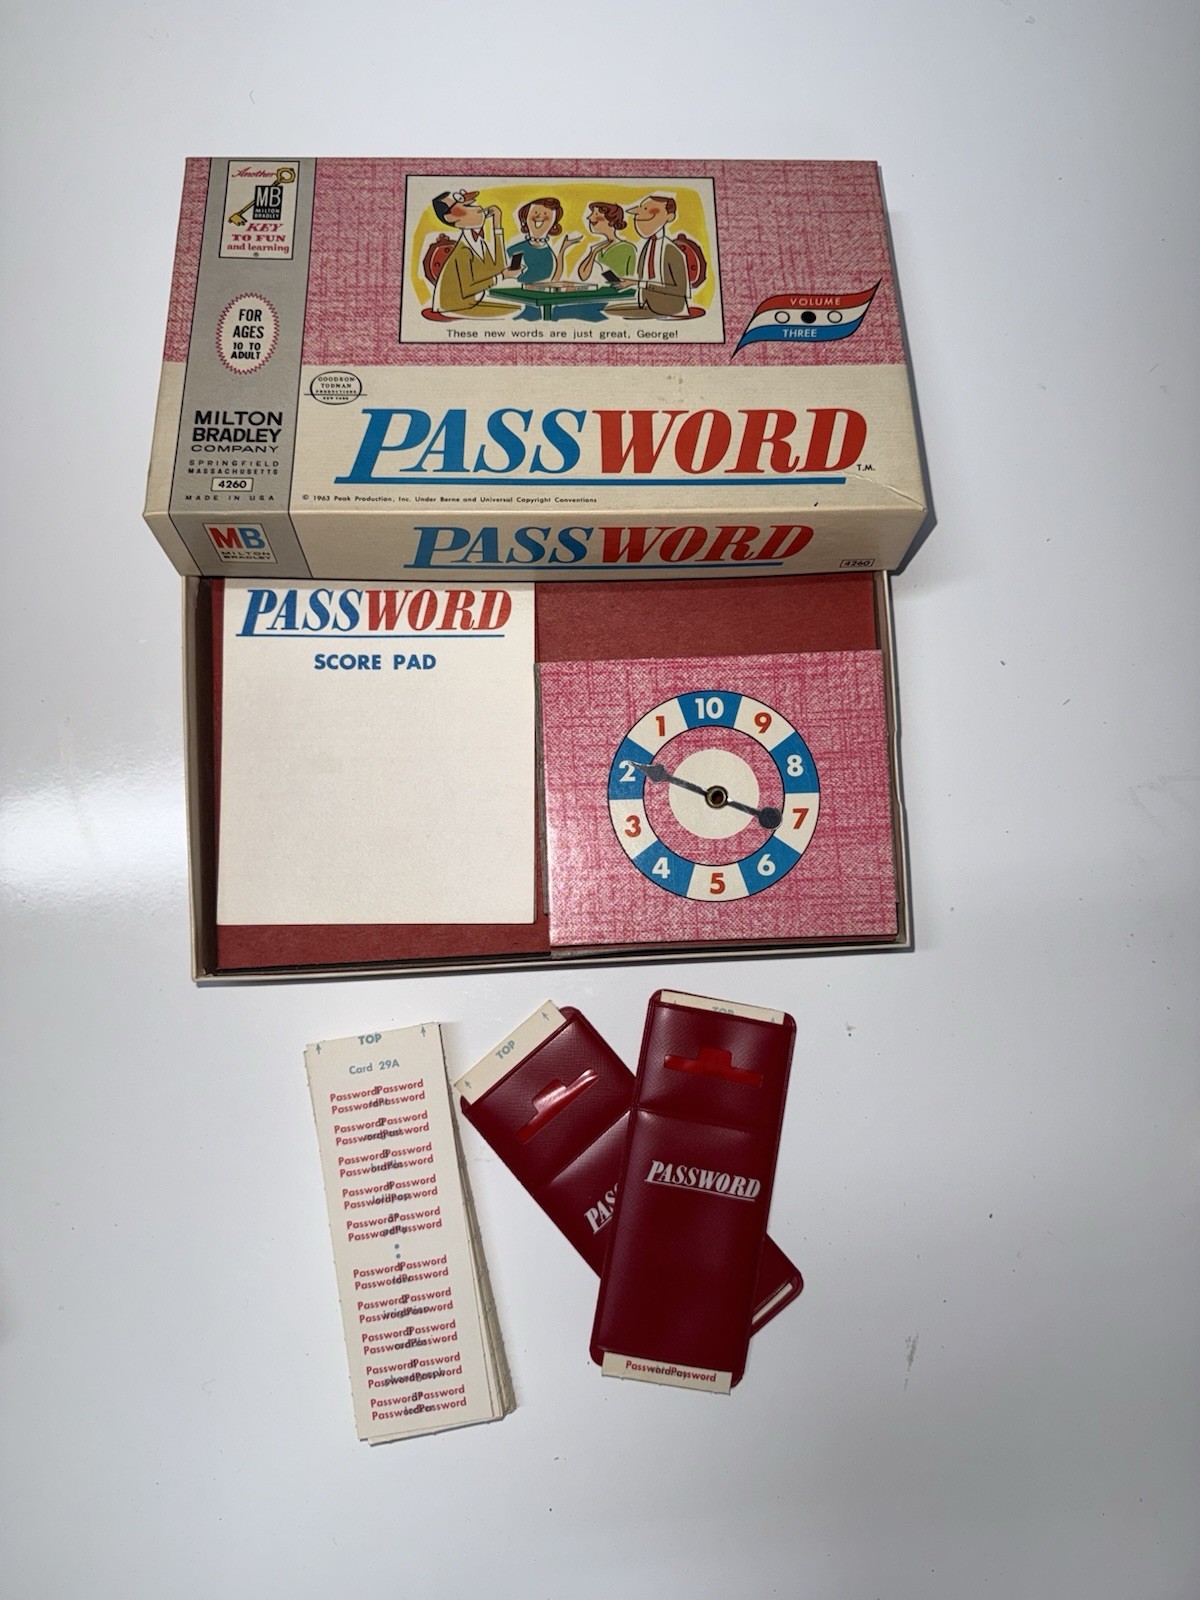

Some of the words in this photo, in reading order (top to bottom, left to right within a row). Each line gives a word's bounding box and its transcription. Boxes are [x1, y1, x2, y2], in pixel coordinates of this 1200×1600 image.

[232, 166, 276, 178] Another
[256, 187, 281, 207] MB
[246, 223, 284, 232] KEY
[256, 234, 286, 242] FUN
[227, 243, 246, 251] and
[248, 243, 290, 254] learning
[790, 296, 841, 306] VOLUME
[238, 309, 262, 322] FOR
[233, 325, 265, 339] AGES
[447, 329, 478, 339] These
[511, 329, 544, 340] words
[549, 332, 568, 340] are
[573, 329, 594, 342] just
[599, 329, 631, 342] great,
[636, 329, 679, 342] George!
[782, 328, 818, 338] THREE
[233, 342, 243, 351] 10
[249, 342, 261, 351] TO
[231, 351, 261, 360] ADULT
[194, 411, 283, 426] MILTON
[192, 428, 282, 443] BRADLEY
[191, 445, 279, 453] COMPANY
[334, 407, 868, 485] PASSWORD
[218, 480, 247, 489] 4260
[208, 528, 265, 548] MB
[404, 525, 814, 569] PASSWORD
[236, 588, 512, 637] PASSWORD
[314, 654, 381, 670] SCORE
[393, 654, 436, 670] PAD
[695, 697, 724, 719] 10
[655, 716, 665, 736] 1
[754, 712, 772, 733] 9
[619, 760, 636, 782] 2
[787, 754, 804, 777] 8
[625, 815, 641, 837] 3
[792, 808, 809, 829] 7
[652, 857, 670, 878] 4
[757, 854, 775, 876] 6
[710, 873, 725, 894] 5
[358, 1033, 382, 1045] TOP
[495, 1040, 517, 1062] TOP
[349, 1063, 373, 1075] Card
[379, 1059, 400, 1071] 29A
[644, 1160, 761, 1202] PASSWORD
